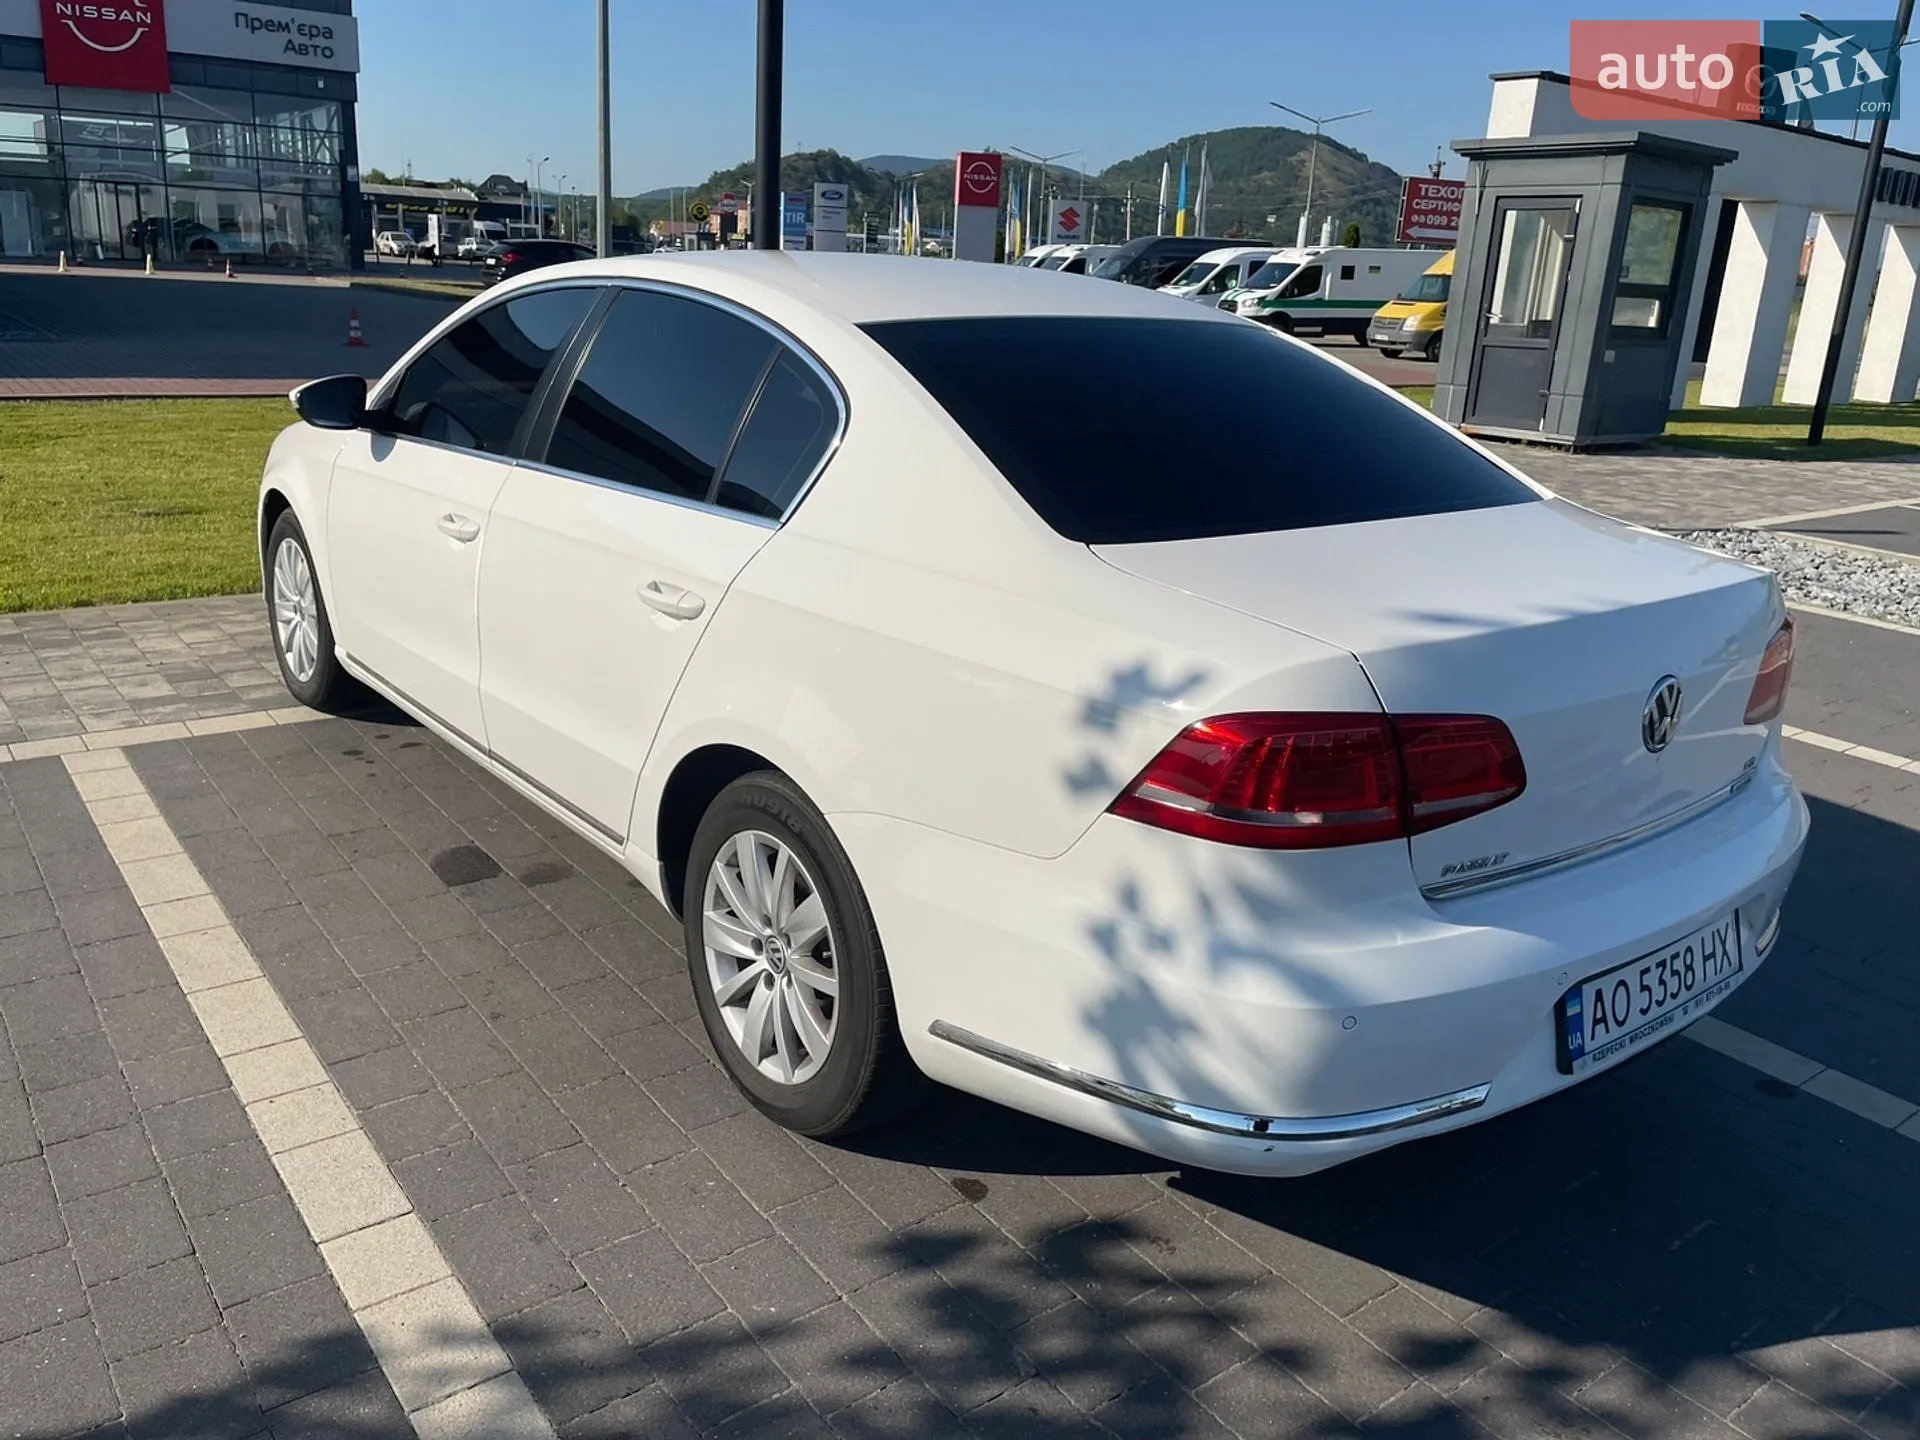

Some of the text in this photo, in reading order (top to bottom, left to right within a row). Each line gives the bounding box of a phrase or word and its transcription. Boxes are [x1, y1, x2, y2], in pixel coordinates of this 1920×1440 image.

[56, 2, 151, 24] NISSAN
[283, 38, 334, 59] Авто
[963, 173, 998, 182] NISSAN
[1426, 214, 1459, 227] 099 2
[1590, 979, 1631, 1041] AO
[1638, 946, 1696, 1016] 5358
[1700, 922, 1733, 982] HX
[1568, 1031, 1583, 1050] UA
